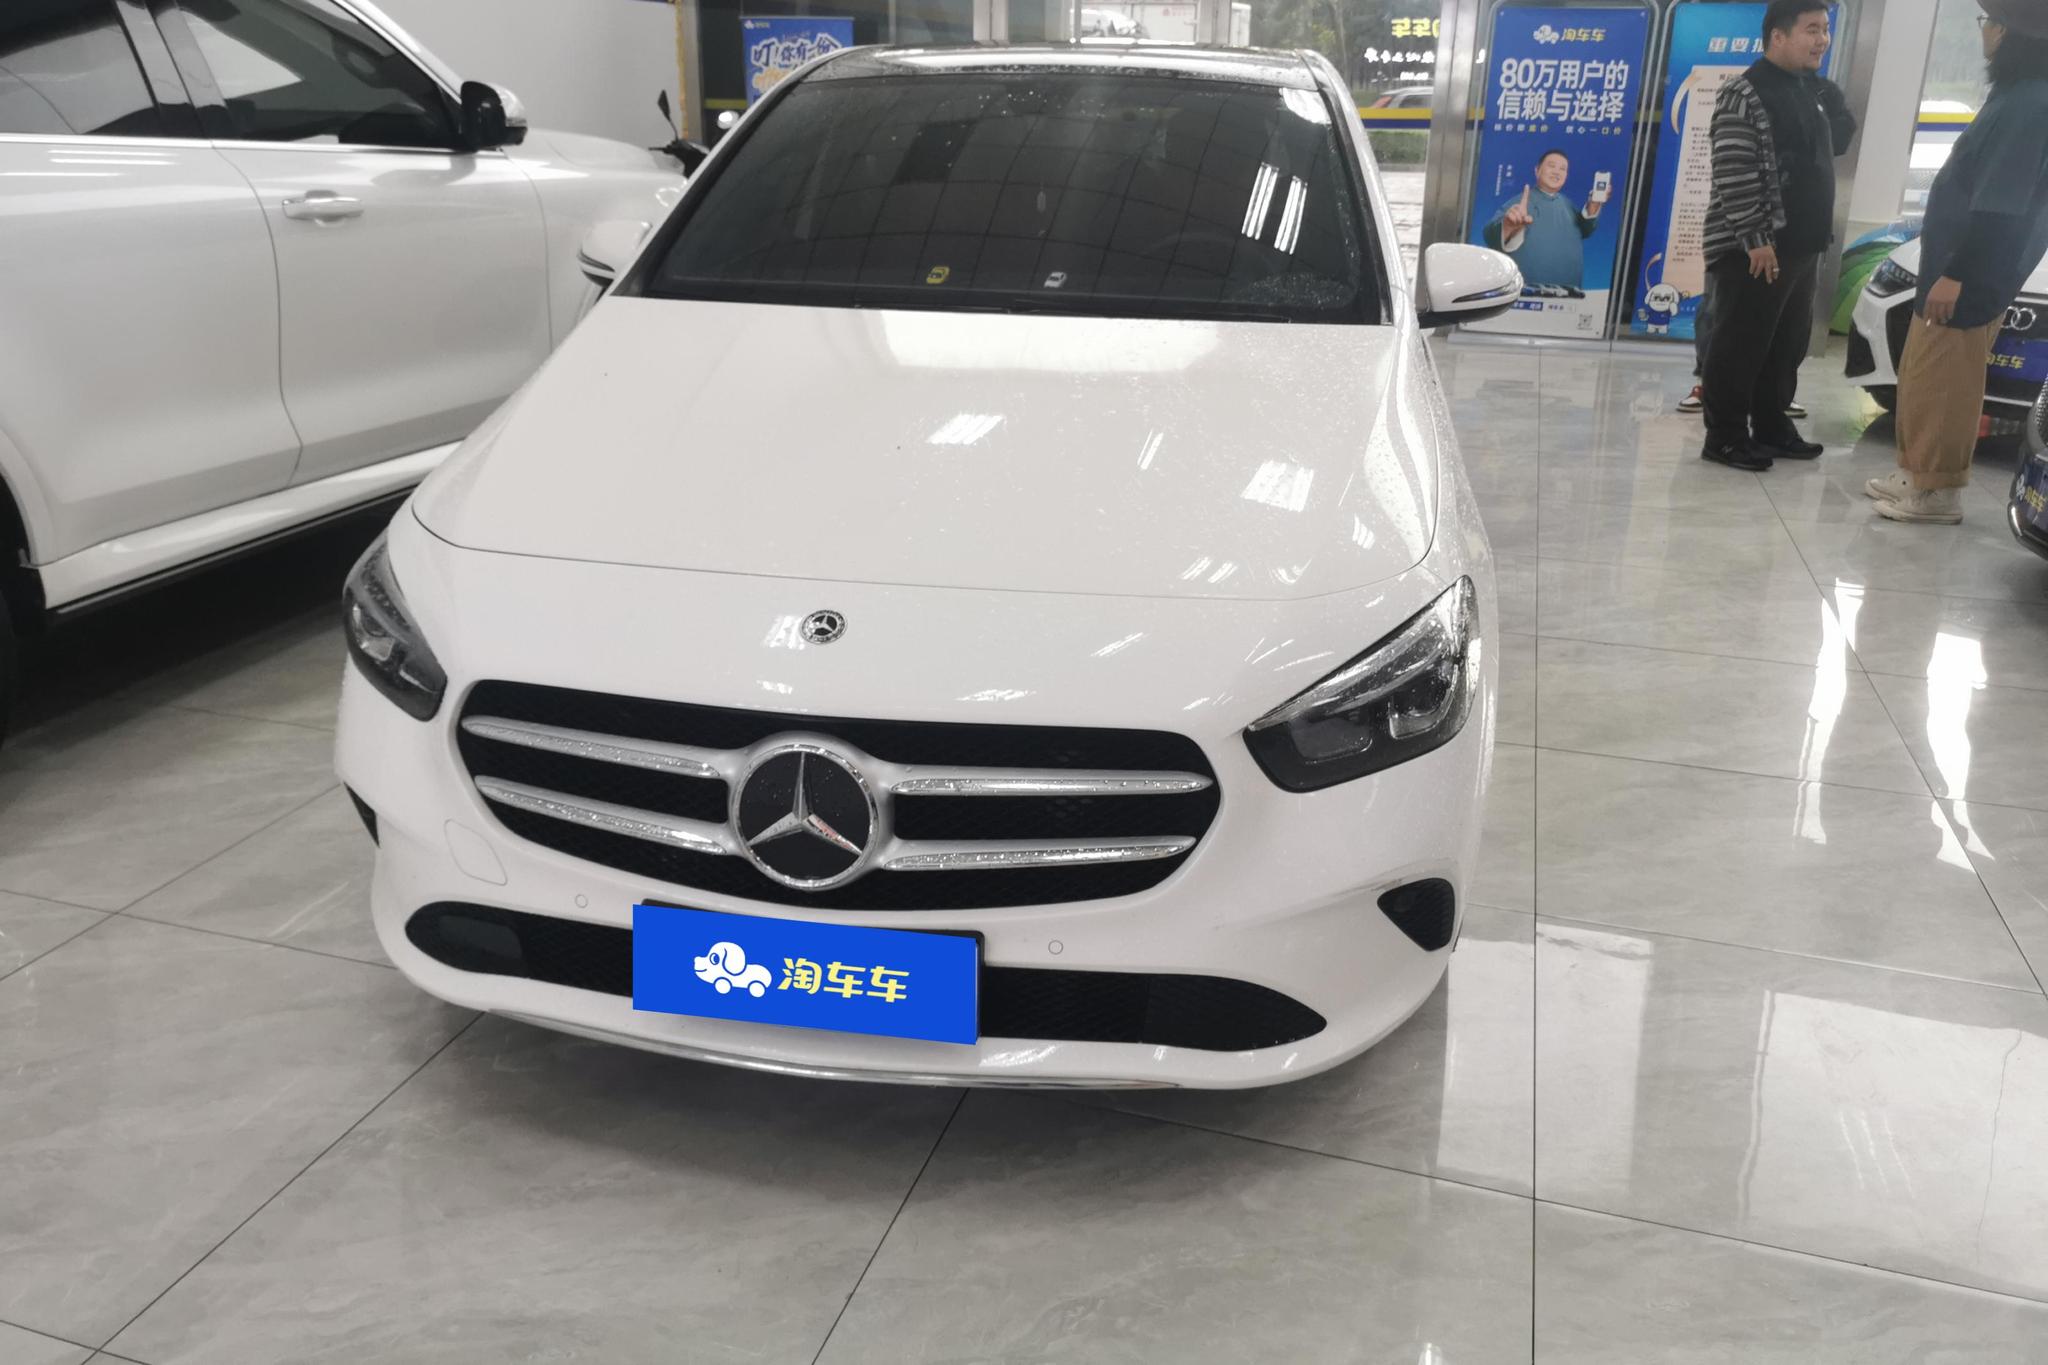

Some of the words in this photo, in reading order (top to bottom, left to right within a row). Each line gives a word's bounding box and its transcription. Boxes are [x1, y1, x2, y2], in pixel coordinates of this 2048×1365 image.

[1561, 28, 1606, 42] 淘车车
[1500, 58, 1629, 90] 80万用户的
[1497, 88, 1624, 123] 信赖与选择
